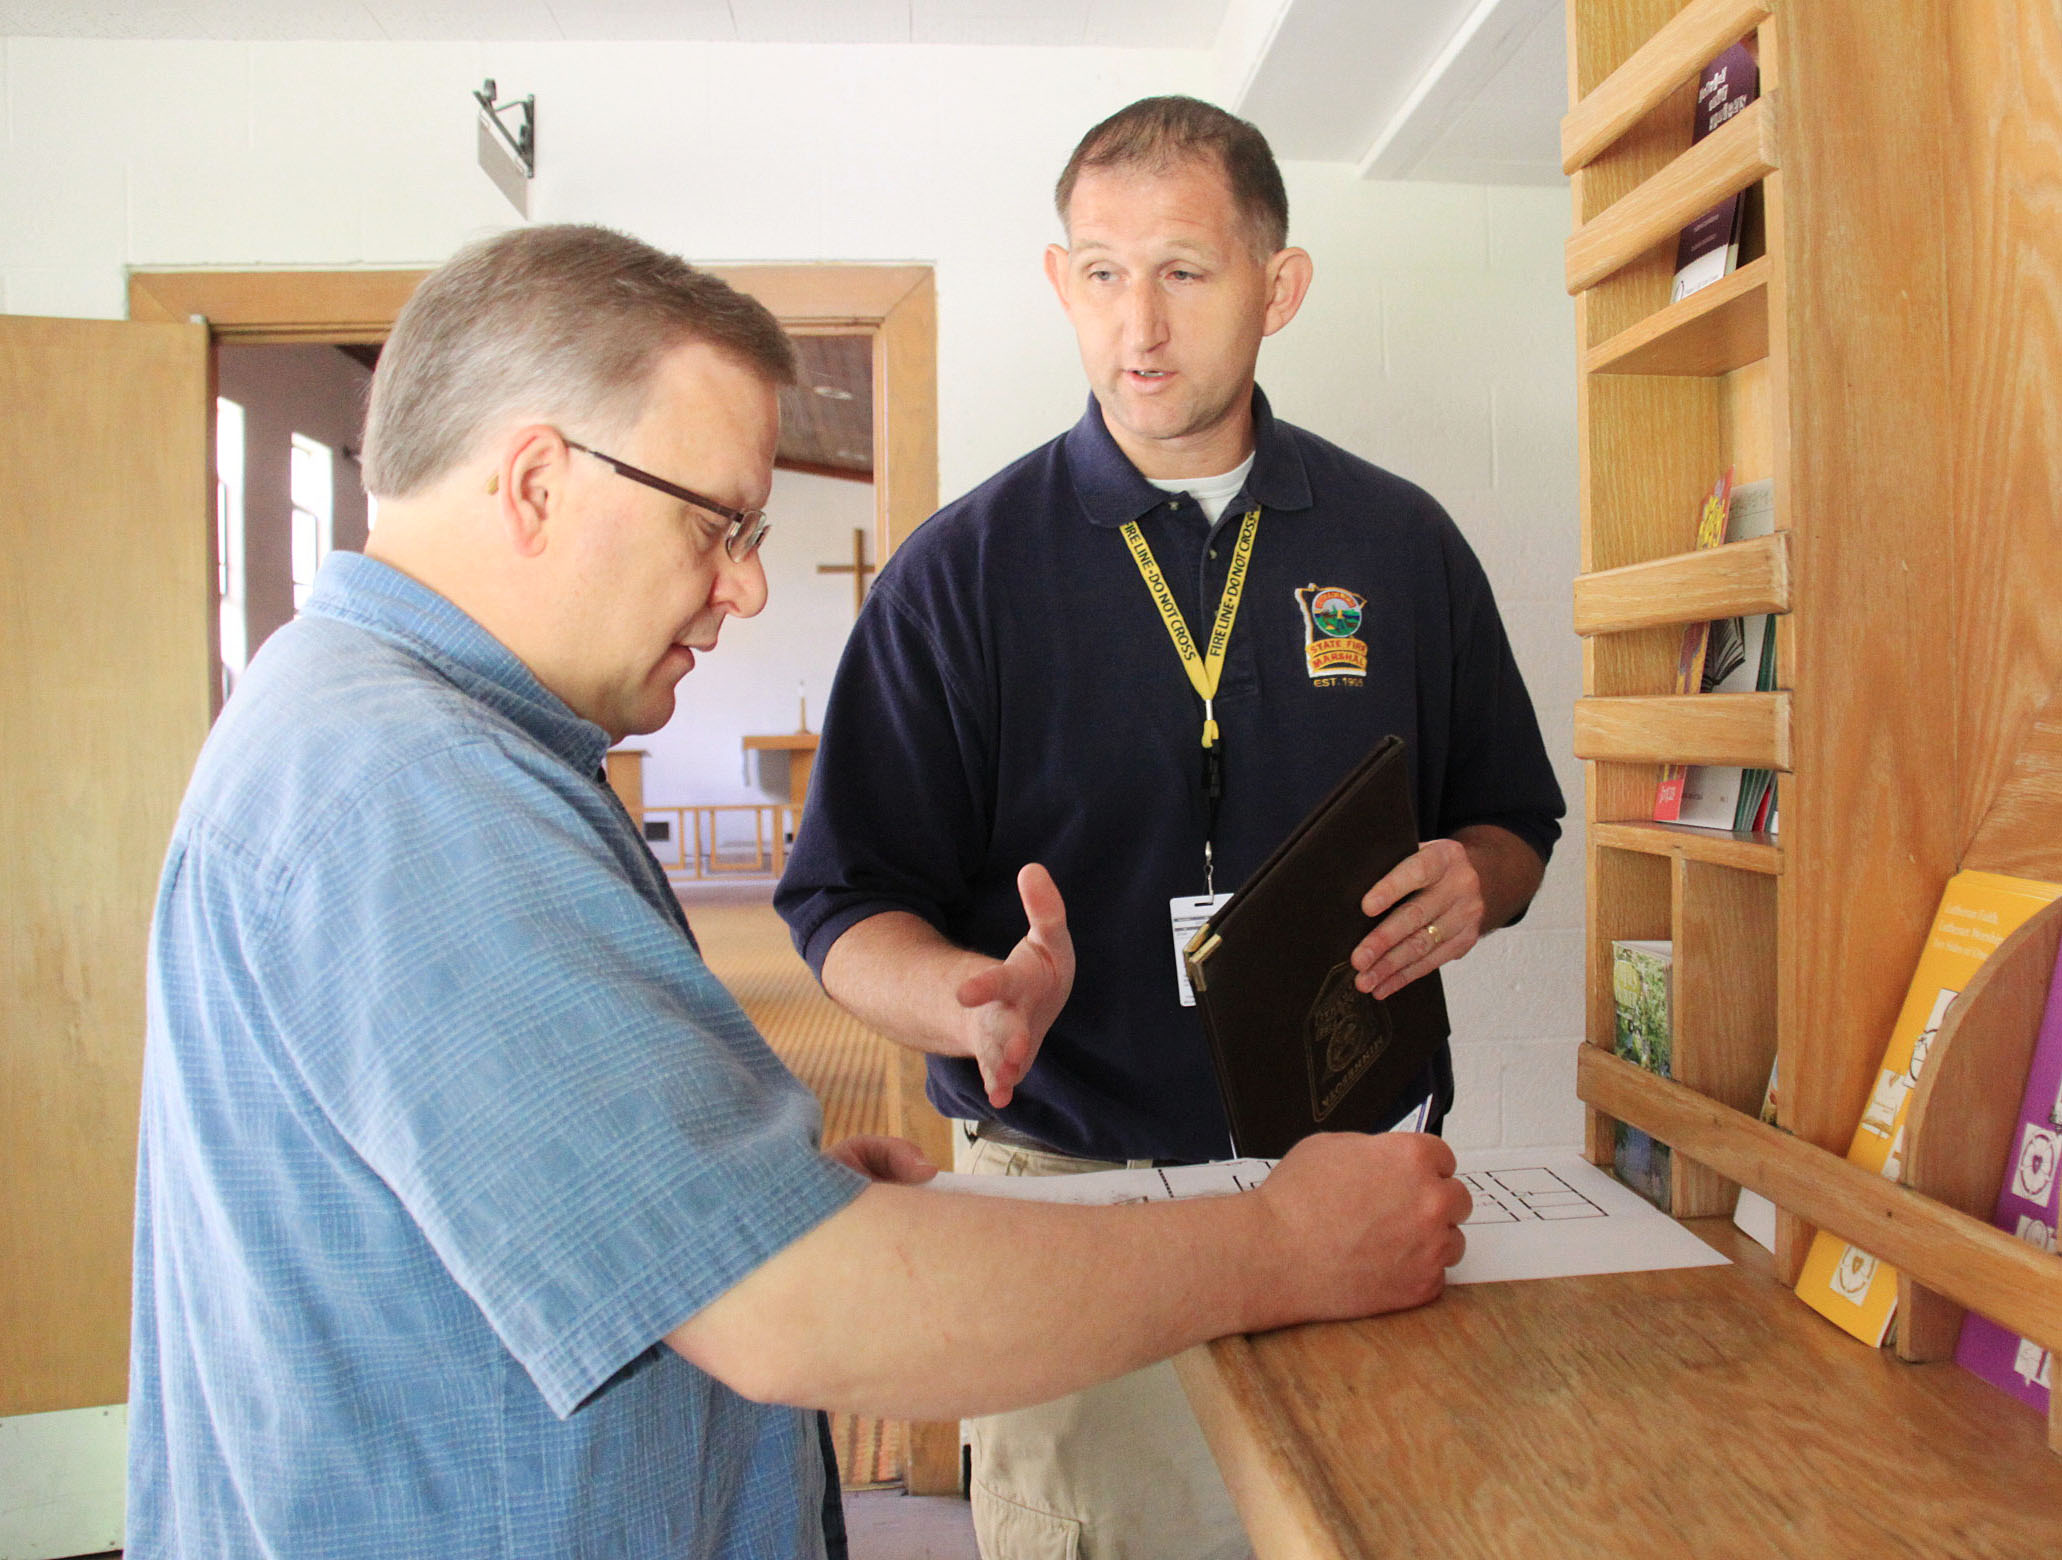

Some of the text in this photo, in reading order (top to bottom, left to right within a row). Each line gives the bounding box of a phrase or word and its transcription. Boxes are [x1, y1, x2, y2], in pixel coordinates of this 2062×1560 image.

[1232, 551, 1247, 577] NOT
[1227, 577, 1241, 596] DO
[1134, 542, 1154, 570] LINE
[1148, 573, 1164, 593] DO
[1159, 593, 1179, 619] NOT
[1170, 619, 1196, 661] CROSS
[1219, 601, 1235, 630] LINE
[1210, 629, 1226, 656] FIRE
[1310, 640, 1366, 654] STATE FIRE
[1312, 652, 1366, 668] MARSHAL
